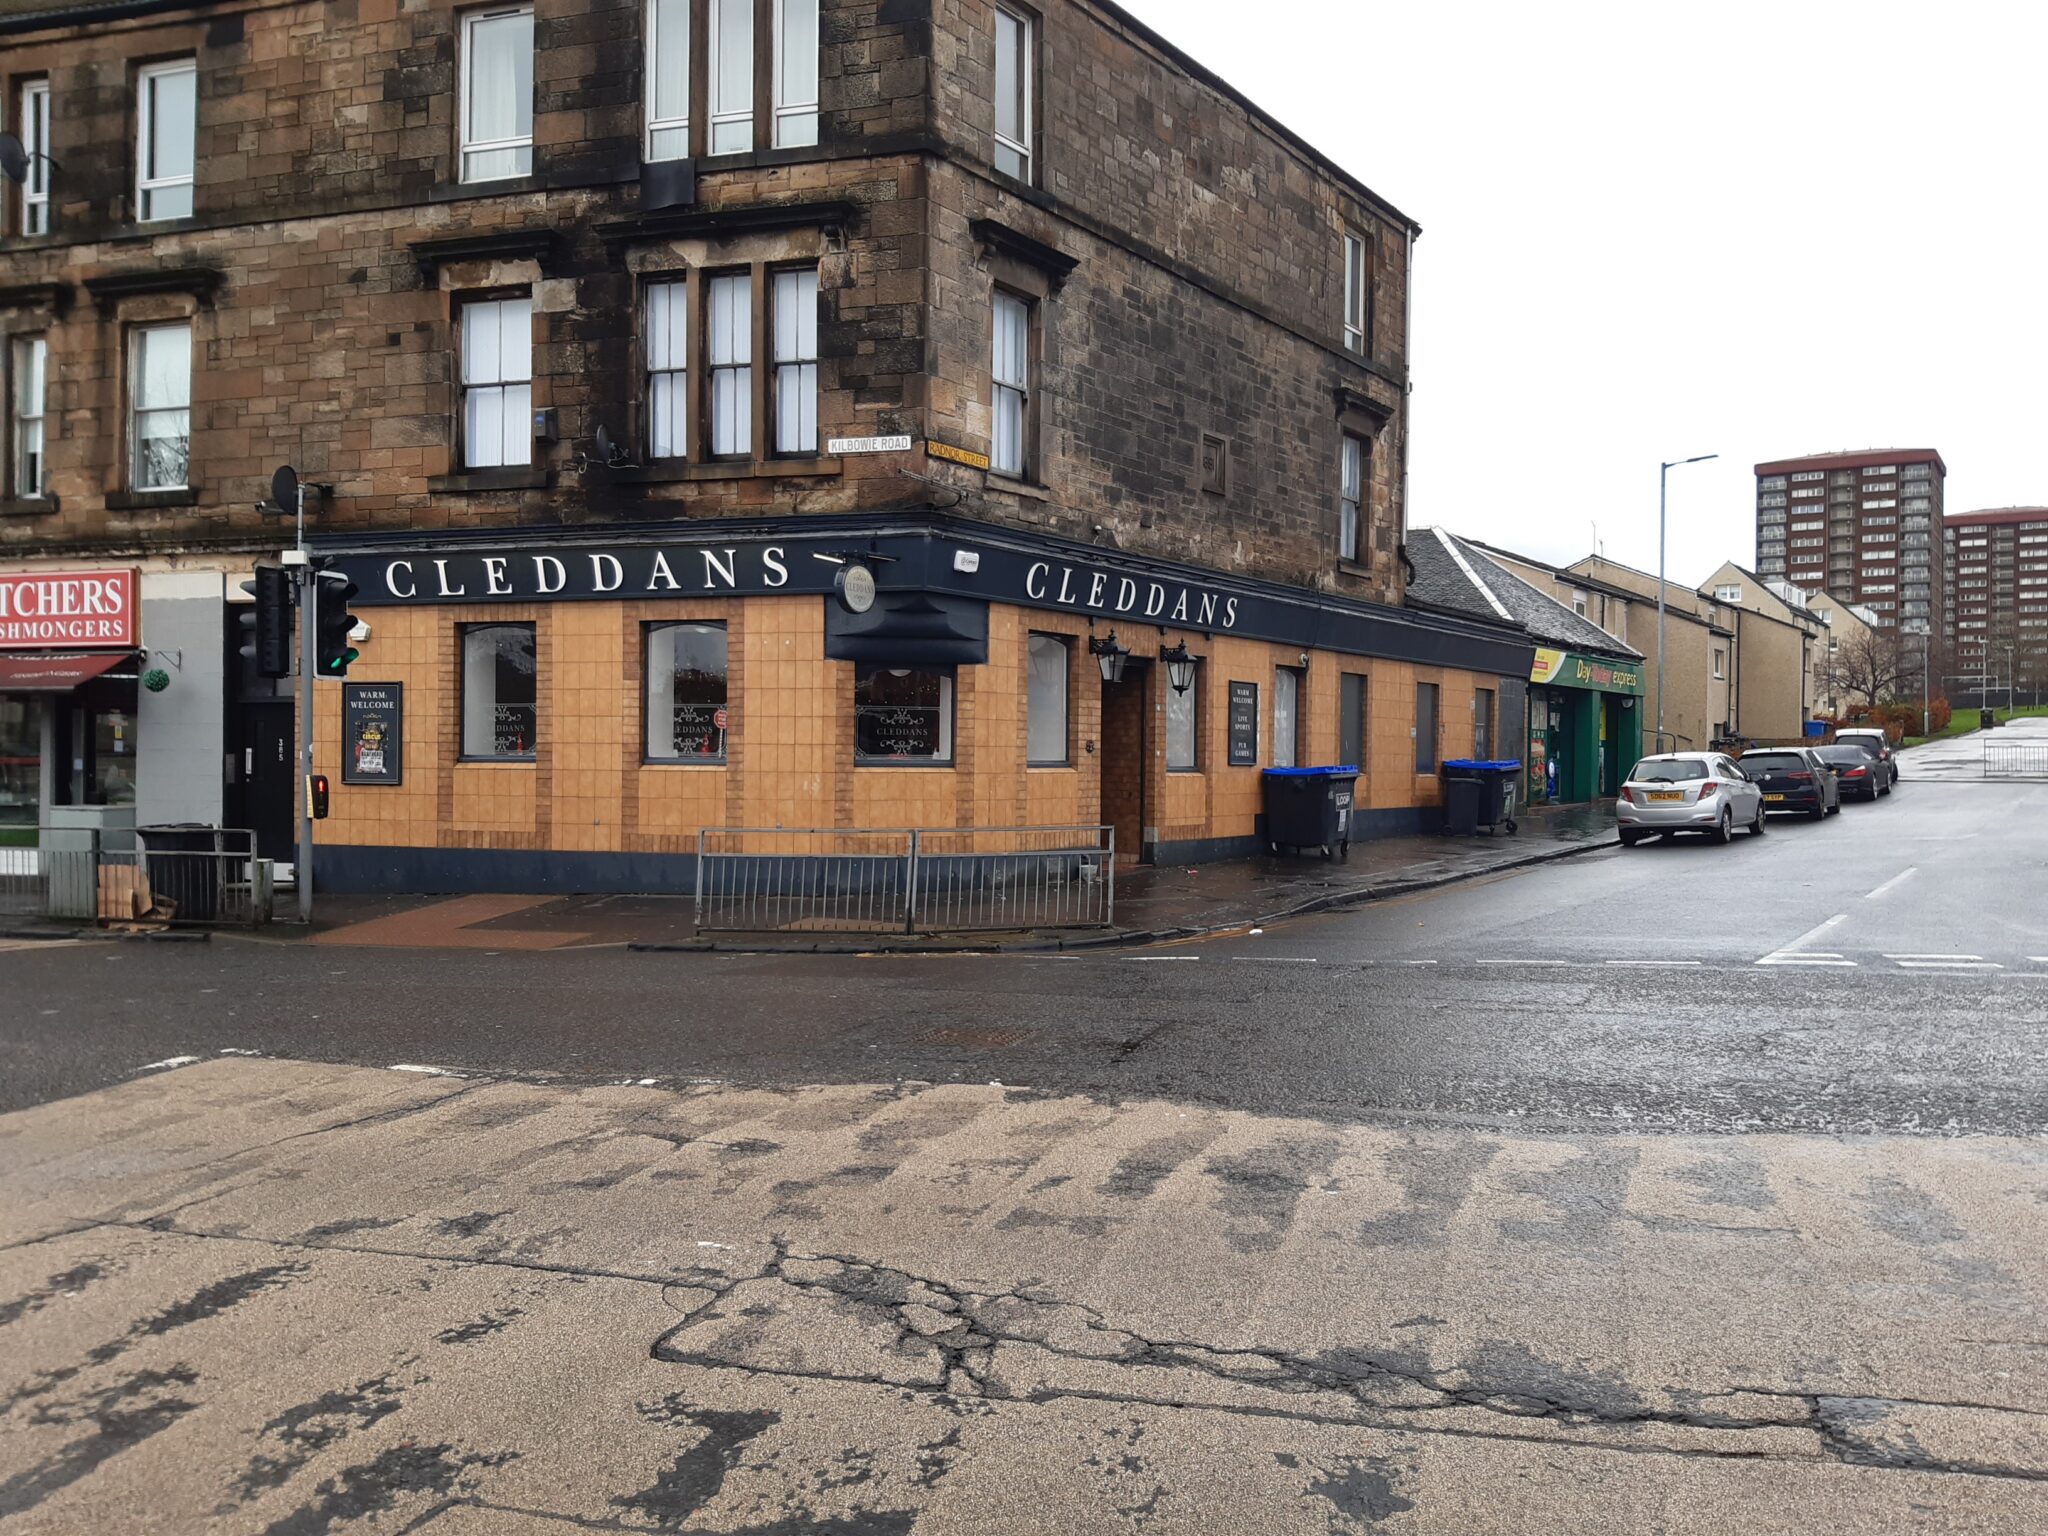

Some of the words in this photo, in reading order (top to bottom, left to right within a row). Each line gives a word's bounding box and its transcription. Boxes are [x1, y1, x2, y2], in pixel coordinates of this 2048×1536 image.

[831, 438, 878, 452] KILBOWIE
[881, 437, 908, 450] ROAD
[929, 442, 961, 461] RADNOR
[963, 453, 988, 467] STREET
[385, 547, 789, 598] CLEDDANS
[0, 579, 122, 617] TCHERS
[1026, 562, 1238, 628] CLEDDANS
[1613, 671, 1637, 688] express
[360, 690, 386, 699] WARM
[1233, 696, 1253, 705] WELCOME
[350, 700, 395, 709] WELCOME
[1238, 715, 1248, 723] LIVE
[676, 726, 713, 734] EDDANS
[876, 728, 928, 736] CLEDDANS
